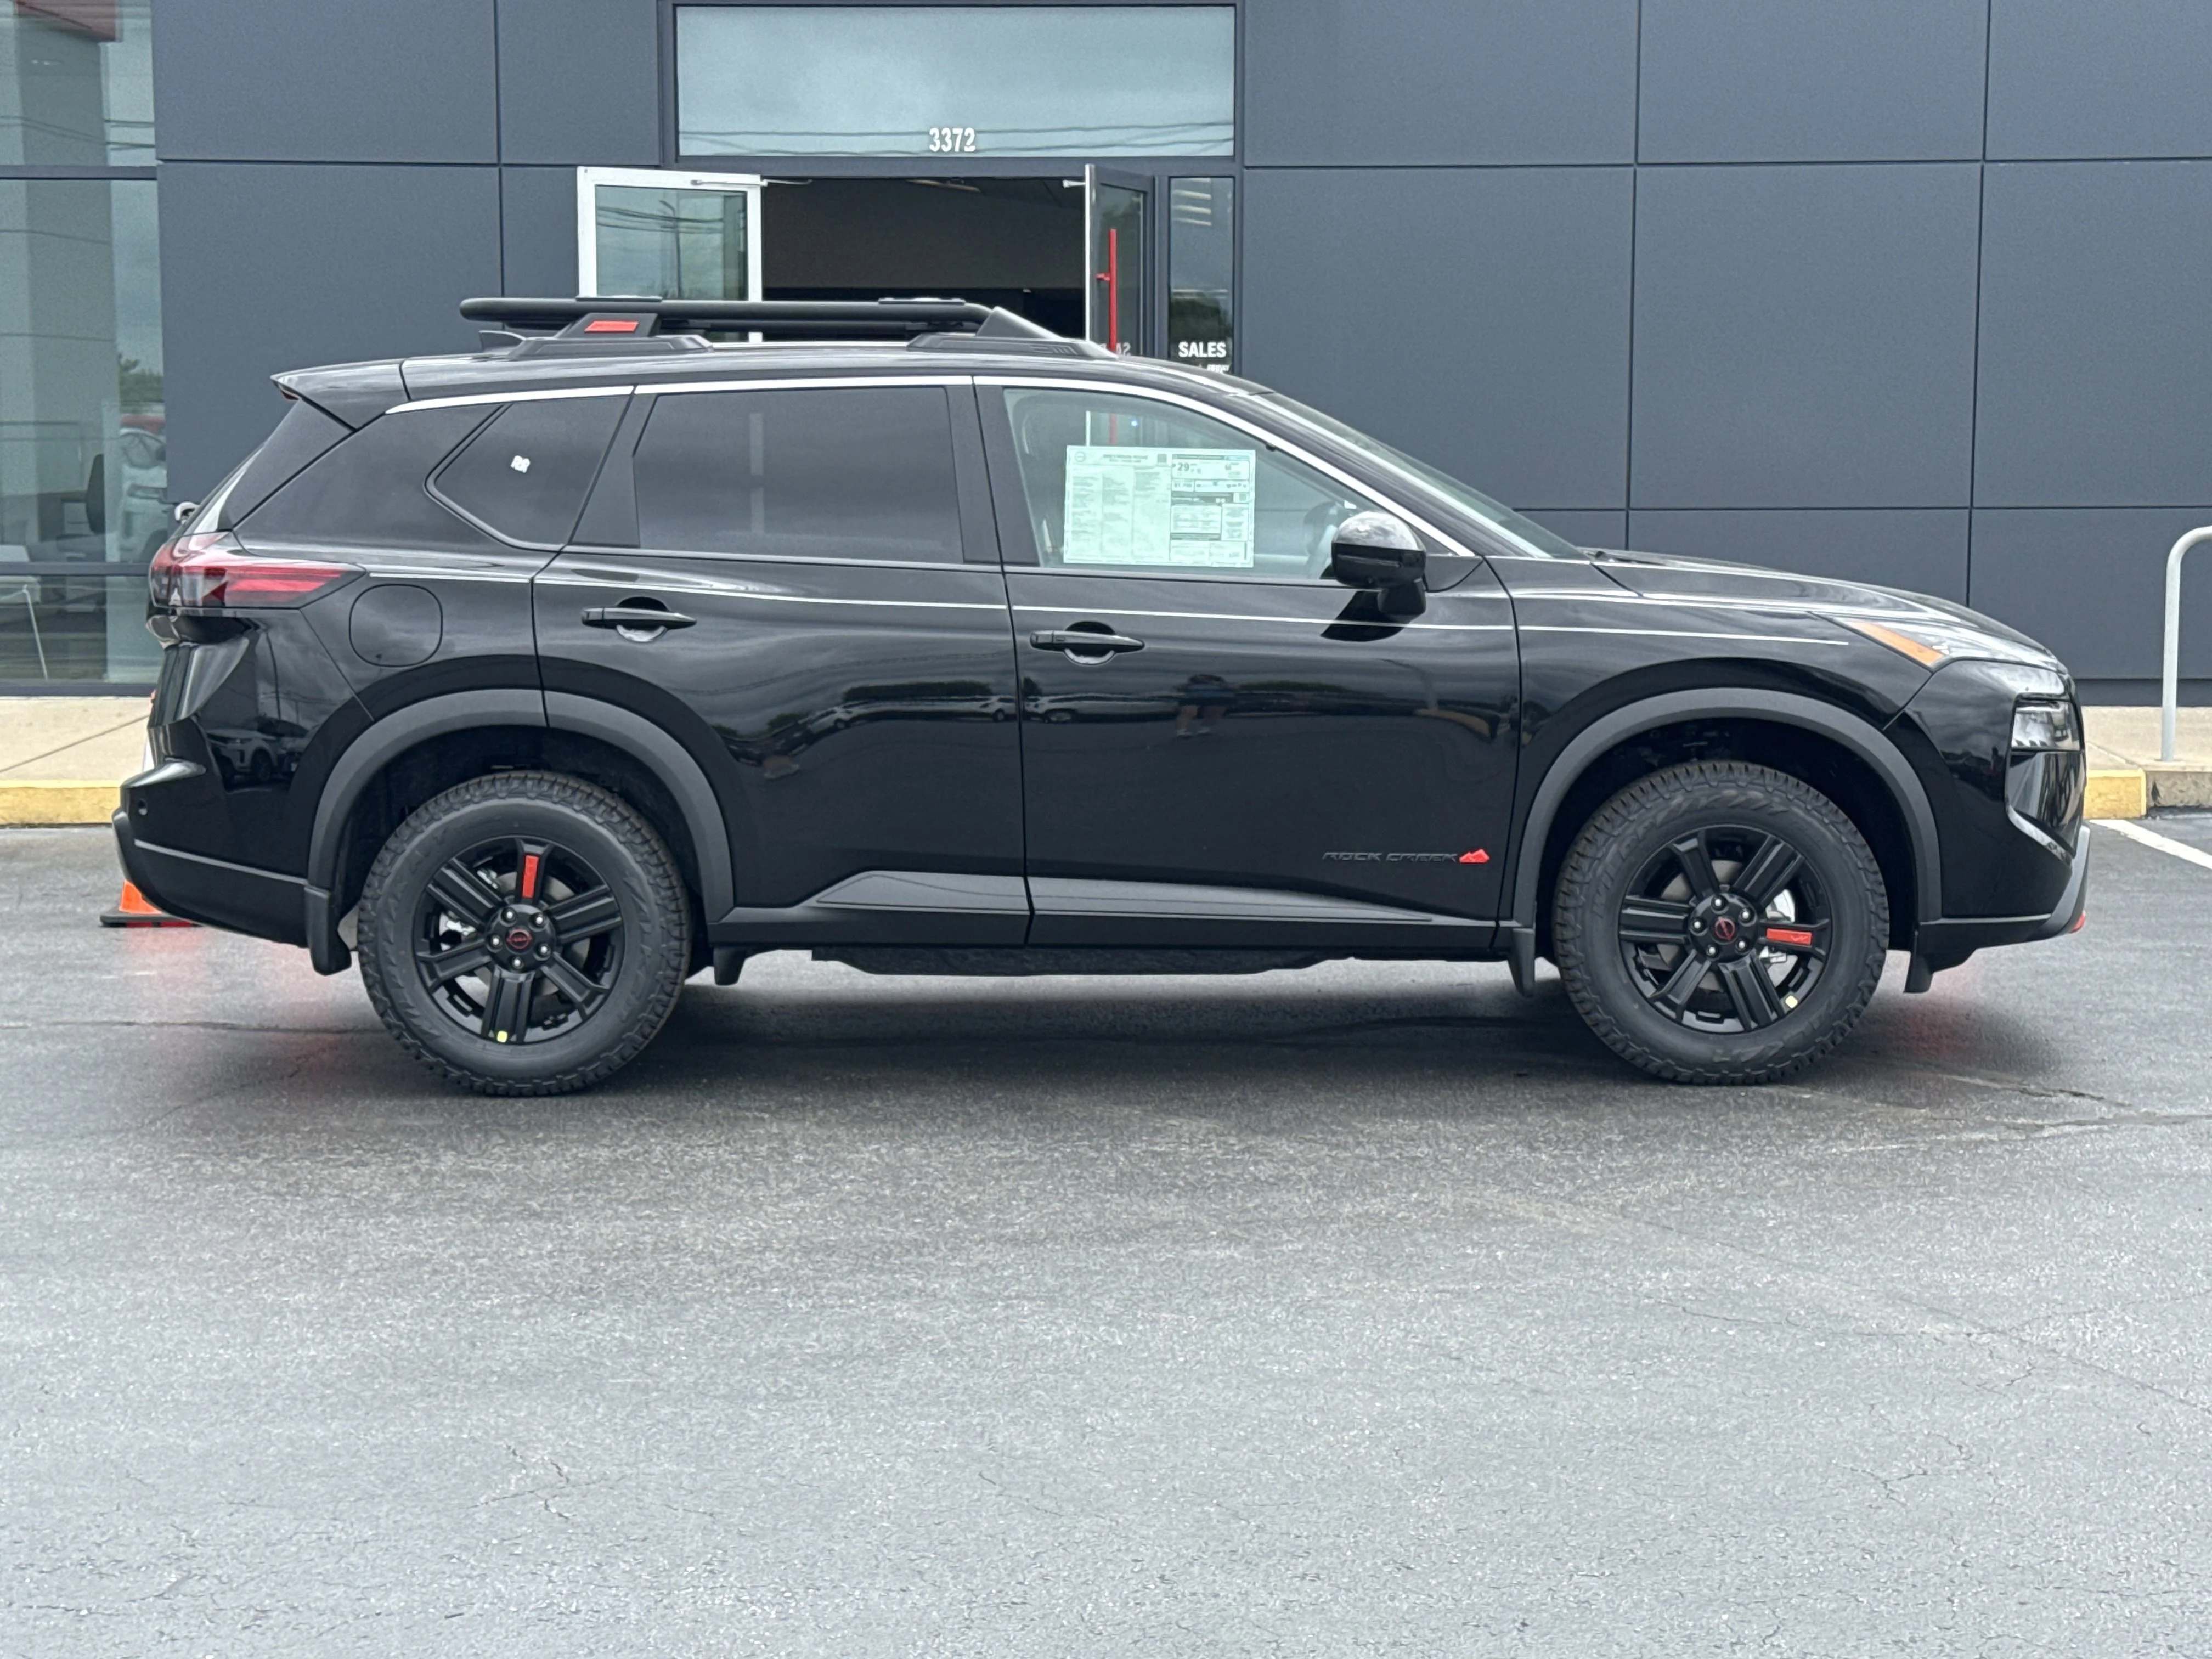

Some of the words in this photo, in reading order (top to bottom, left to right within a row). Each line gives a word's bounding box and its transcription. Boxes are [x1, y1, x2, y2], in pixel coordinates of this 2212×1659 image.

[929, 127, 975, 152] 3372
[1178, 341, 1227, 357] SALES
[1177, 462, 1190, 472] 29
[1322, 851, 1383, 862] ROCK
[1386, 853, 1458, 863] CREEK
